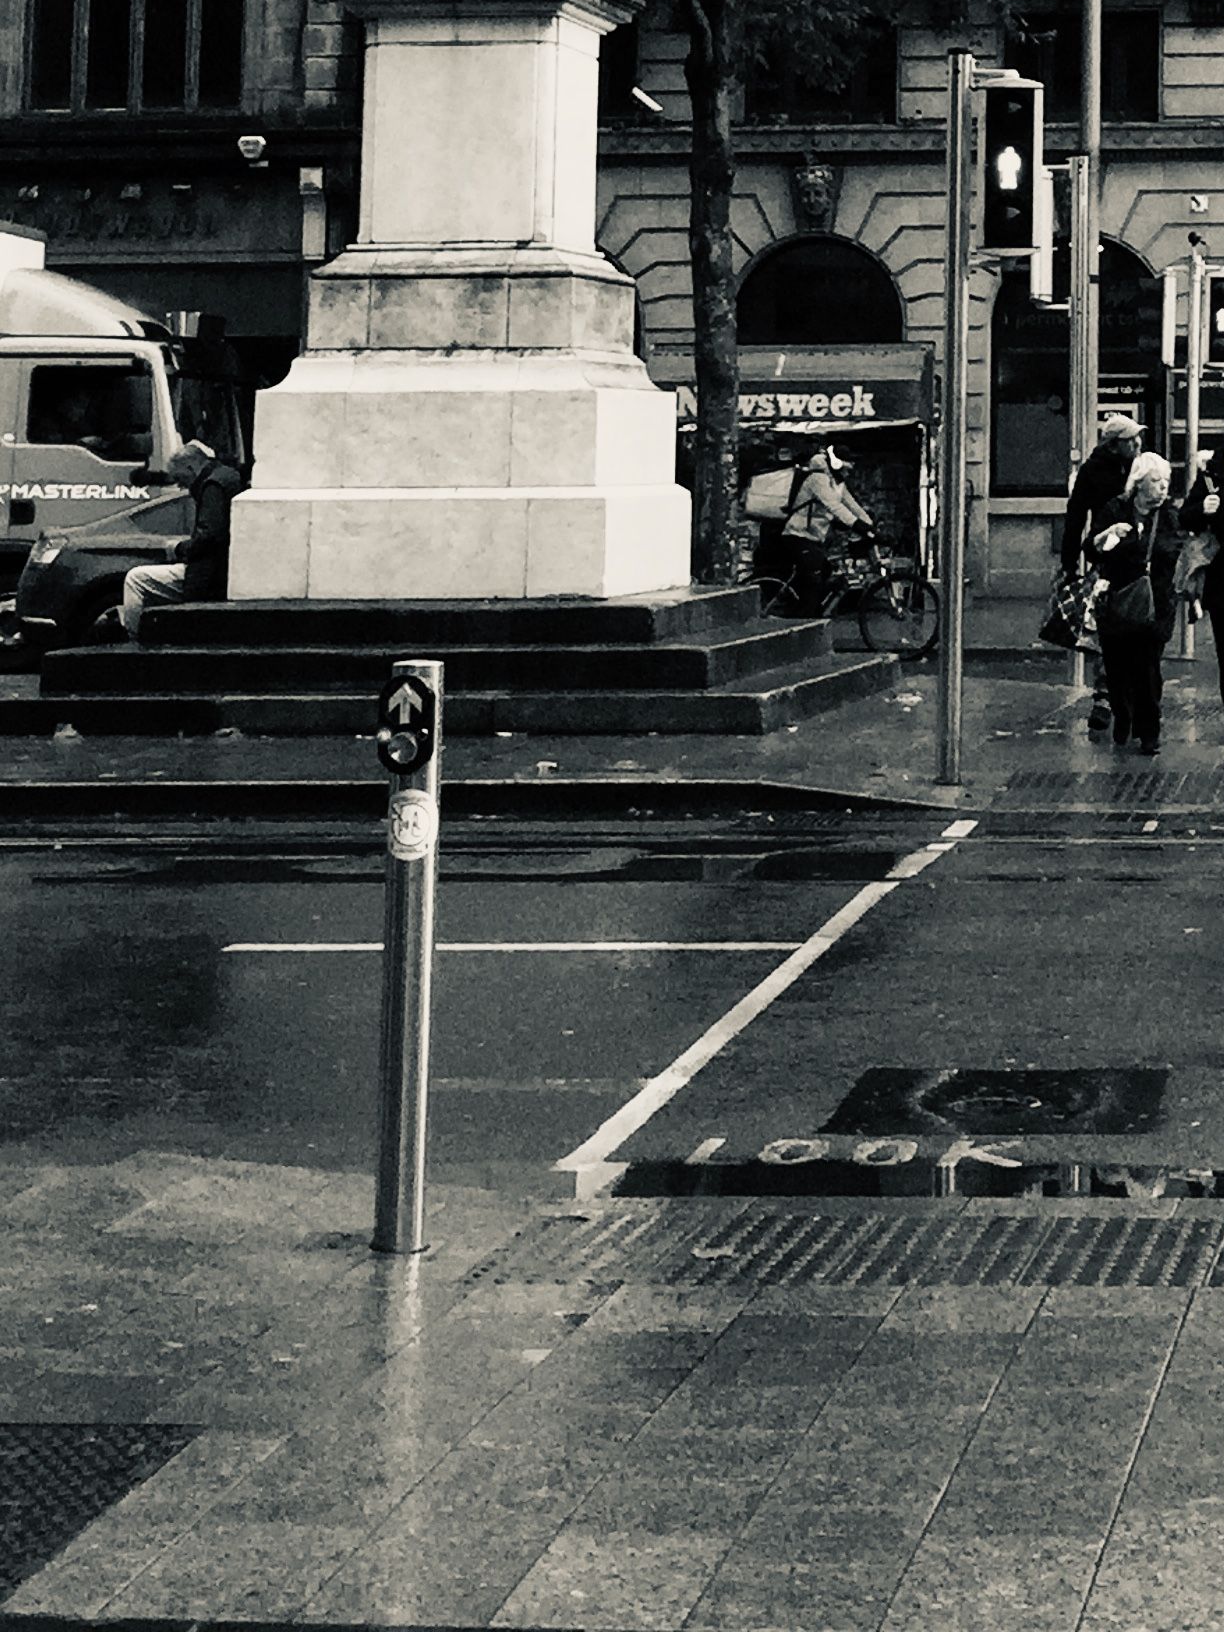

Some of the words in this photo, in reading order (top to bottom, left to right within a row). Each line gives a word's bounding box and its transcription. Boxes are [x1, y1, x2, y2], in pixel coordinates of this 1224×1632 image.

[676, 385, 876, 417] Nsweek
[10, 484, 150, 499] MASTERLINK
[685, 1137, 1023, 1167] LOOK
